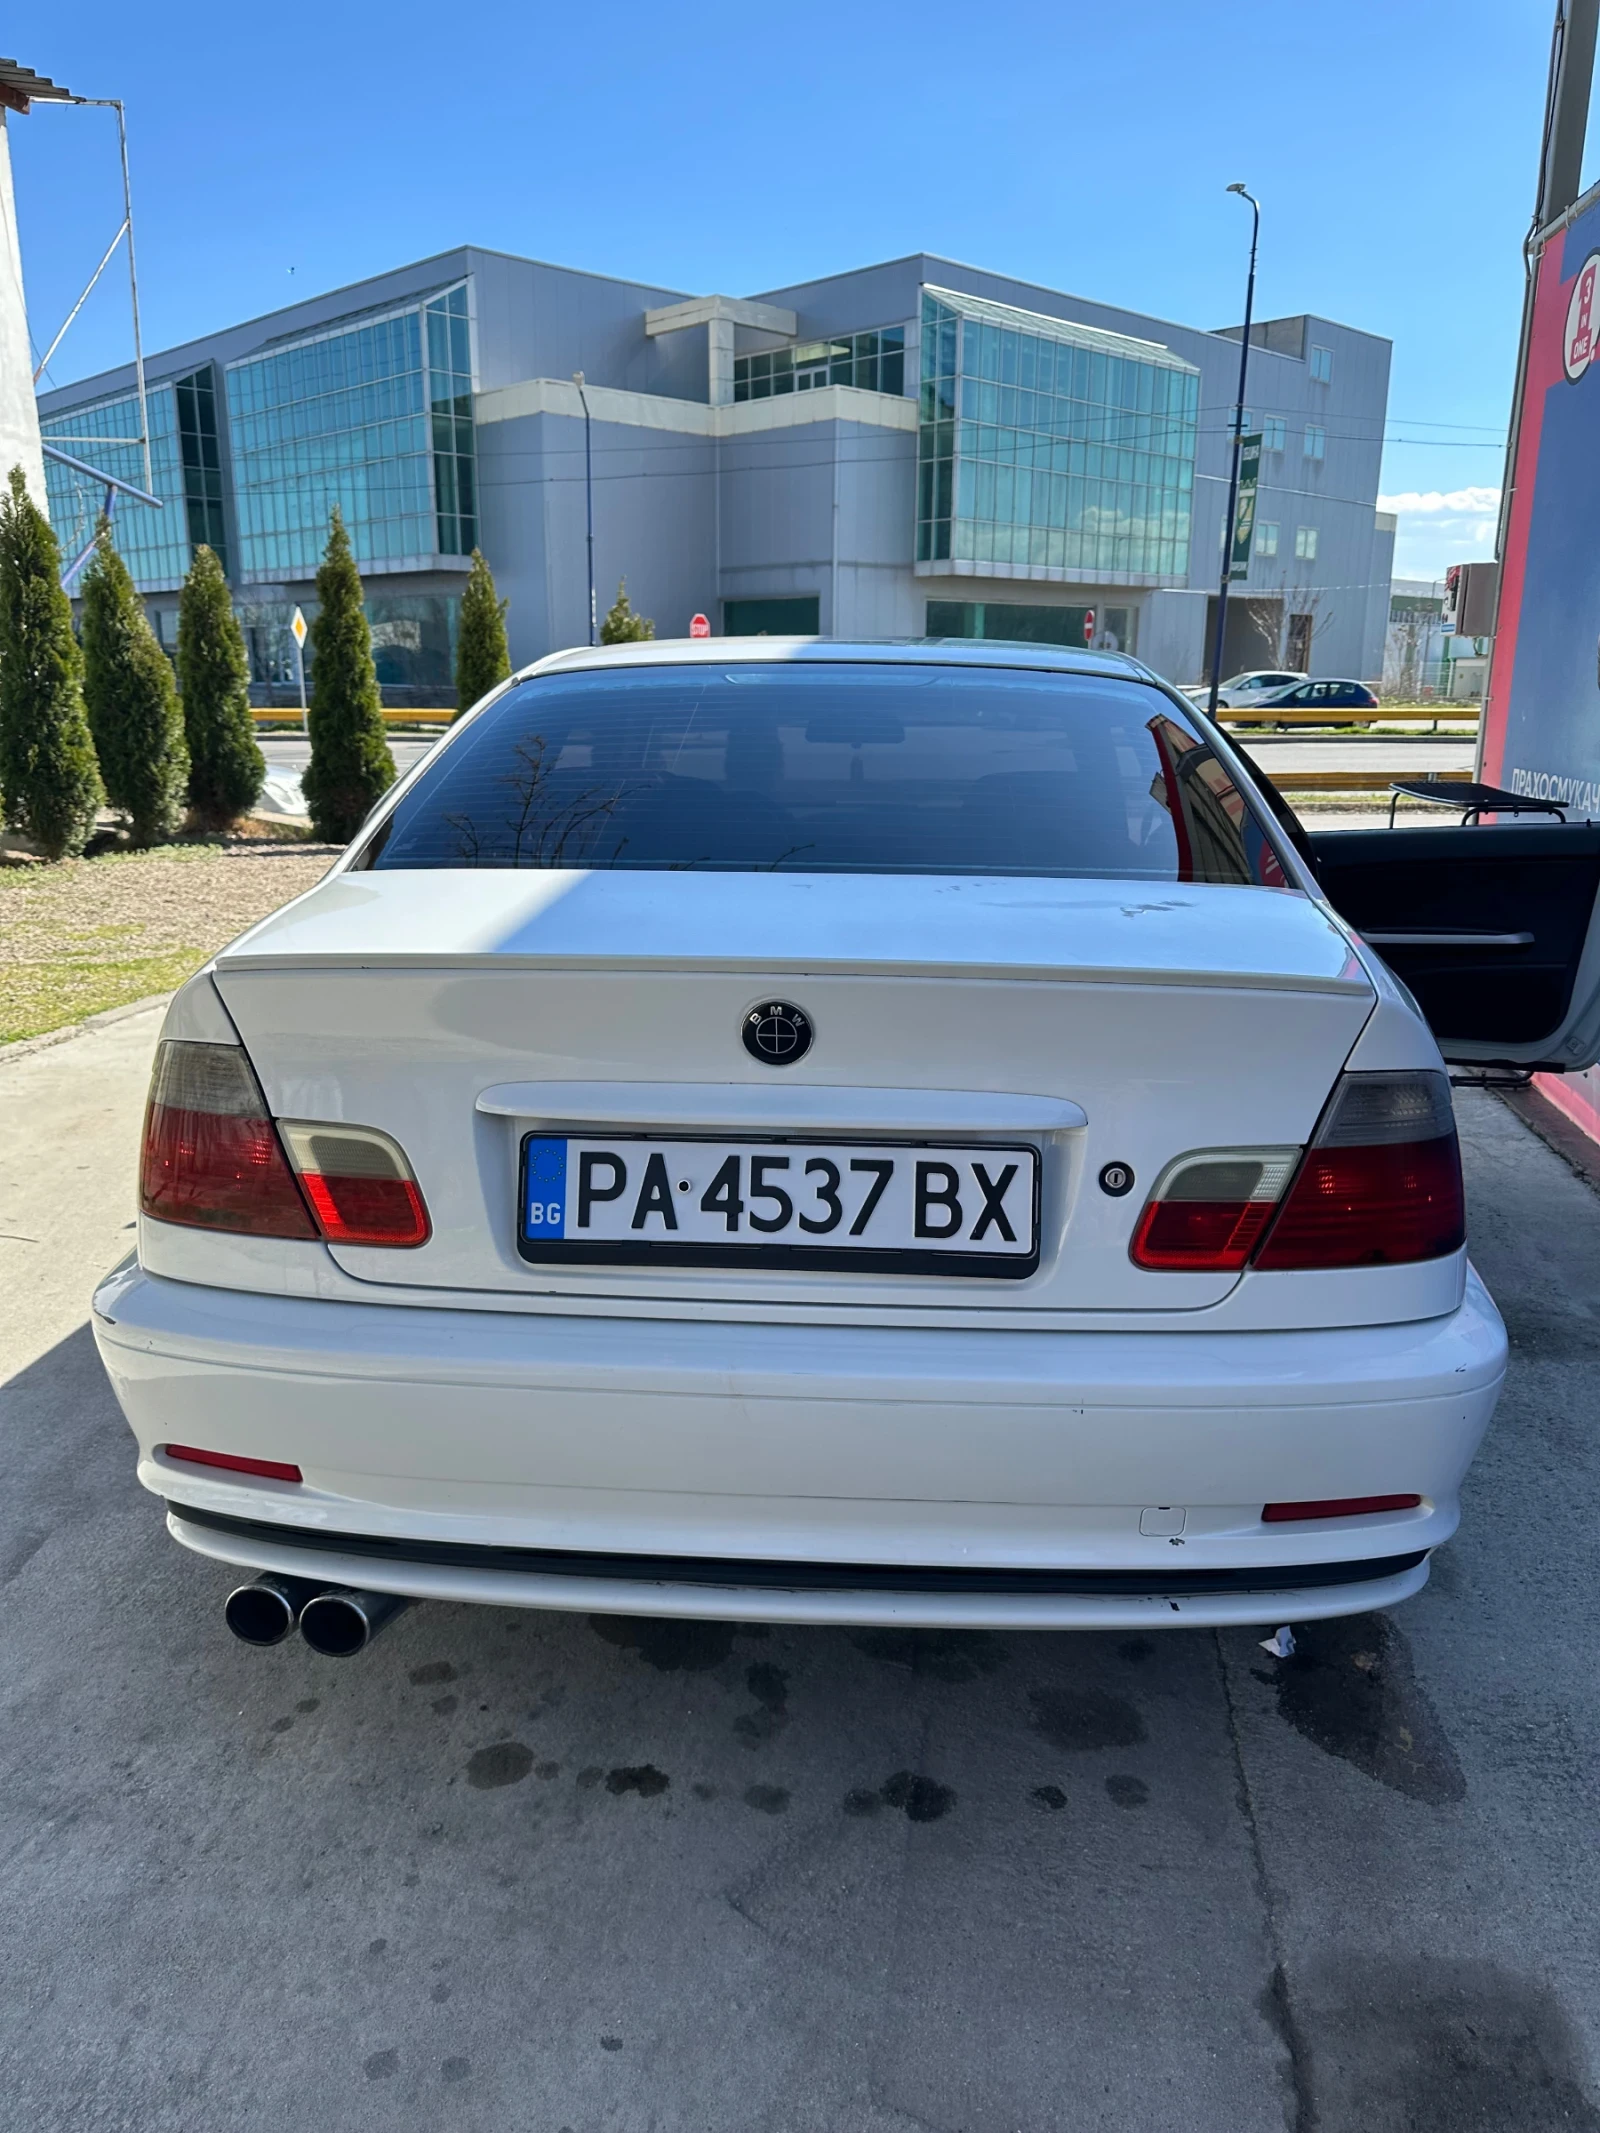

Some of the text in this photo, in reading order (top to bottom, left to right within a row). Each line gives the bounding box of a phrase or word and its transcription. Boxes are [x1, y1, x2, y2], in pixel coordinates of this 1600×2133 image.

[1584, 276, 1592, 304] 3
[1580, 313, 1588, 329] IN
[1573, 335, 1589, 360] ONE
[693, 624, 709, 636] STOP
[749, 1005, 805, 1027] BMW
[577, 1151, 1020, 1242] PA 4537 BX
[529, 1202, 561, 1225] BG
